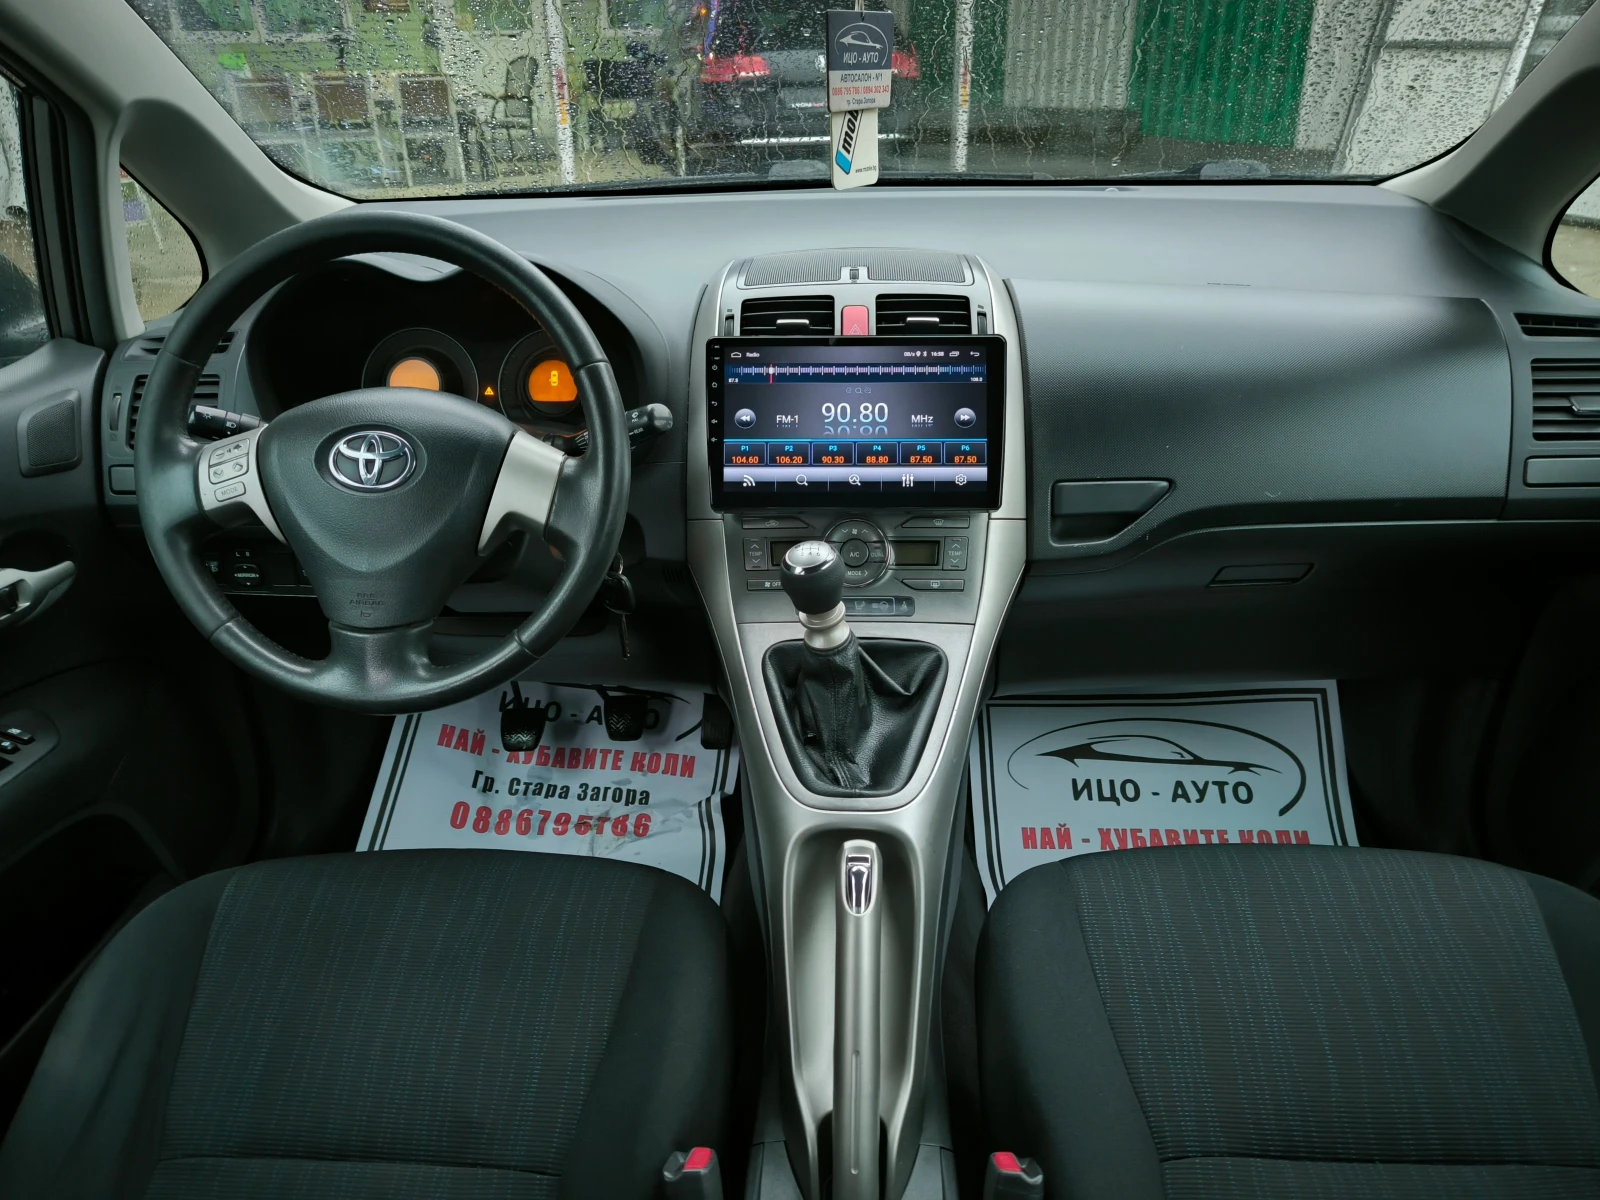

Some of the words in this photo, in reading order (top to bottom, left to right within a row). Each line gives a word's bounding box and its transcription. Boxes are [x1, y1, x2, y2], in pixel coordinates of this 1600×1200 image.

[843, 52, 858, 65] ИЦО
[862, 52, 879, 64] АУТО
[840, 74, 872, 83] АВТОСАЛОН
[776, 415, 799, 424] FM-1
[821, 402, 889, 423] 90.80
[911, 414, 934, 423] MHz
[731, 456, 759, 464] 104.60
[775, 456, 803, 464] 106.20
[821, 456, 845, 464] 90.30
[866, 456, 889, 464] 88.80
[910, 456, 933, 464] 87.50
[954, 456, 977, 464] 87.50
[221, 486, 239, 496] MODE
[437, 724, 486, 756] НАЙ
[506, 745, 624, 771] ХУБАВИТЕ
[630, 751, 696, 778] КОЛИ
[471, 769, 500, 794] Гр.
[507, 777, 570, 800] Стара
[577, 783, 651, 807] Загора
[1071, 777, 1141, 806] ИЦО
[1171, 780, 1254, 804] АУТО
[1021, 823, 1073, 850] НАЙ
